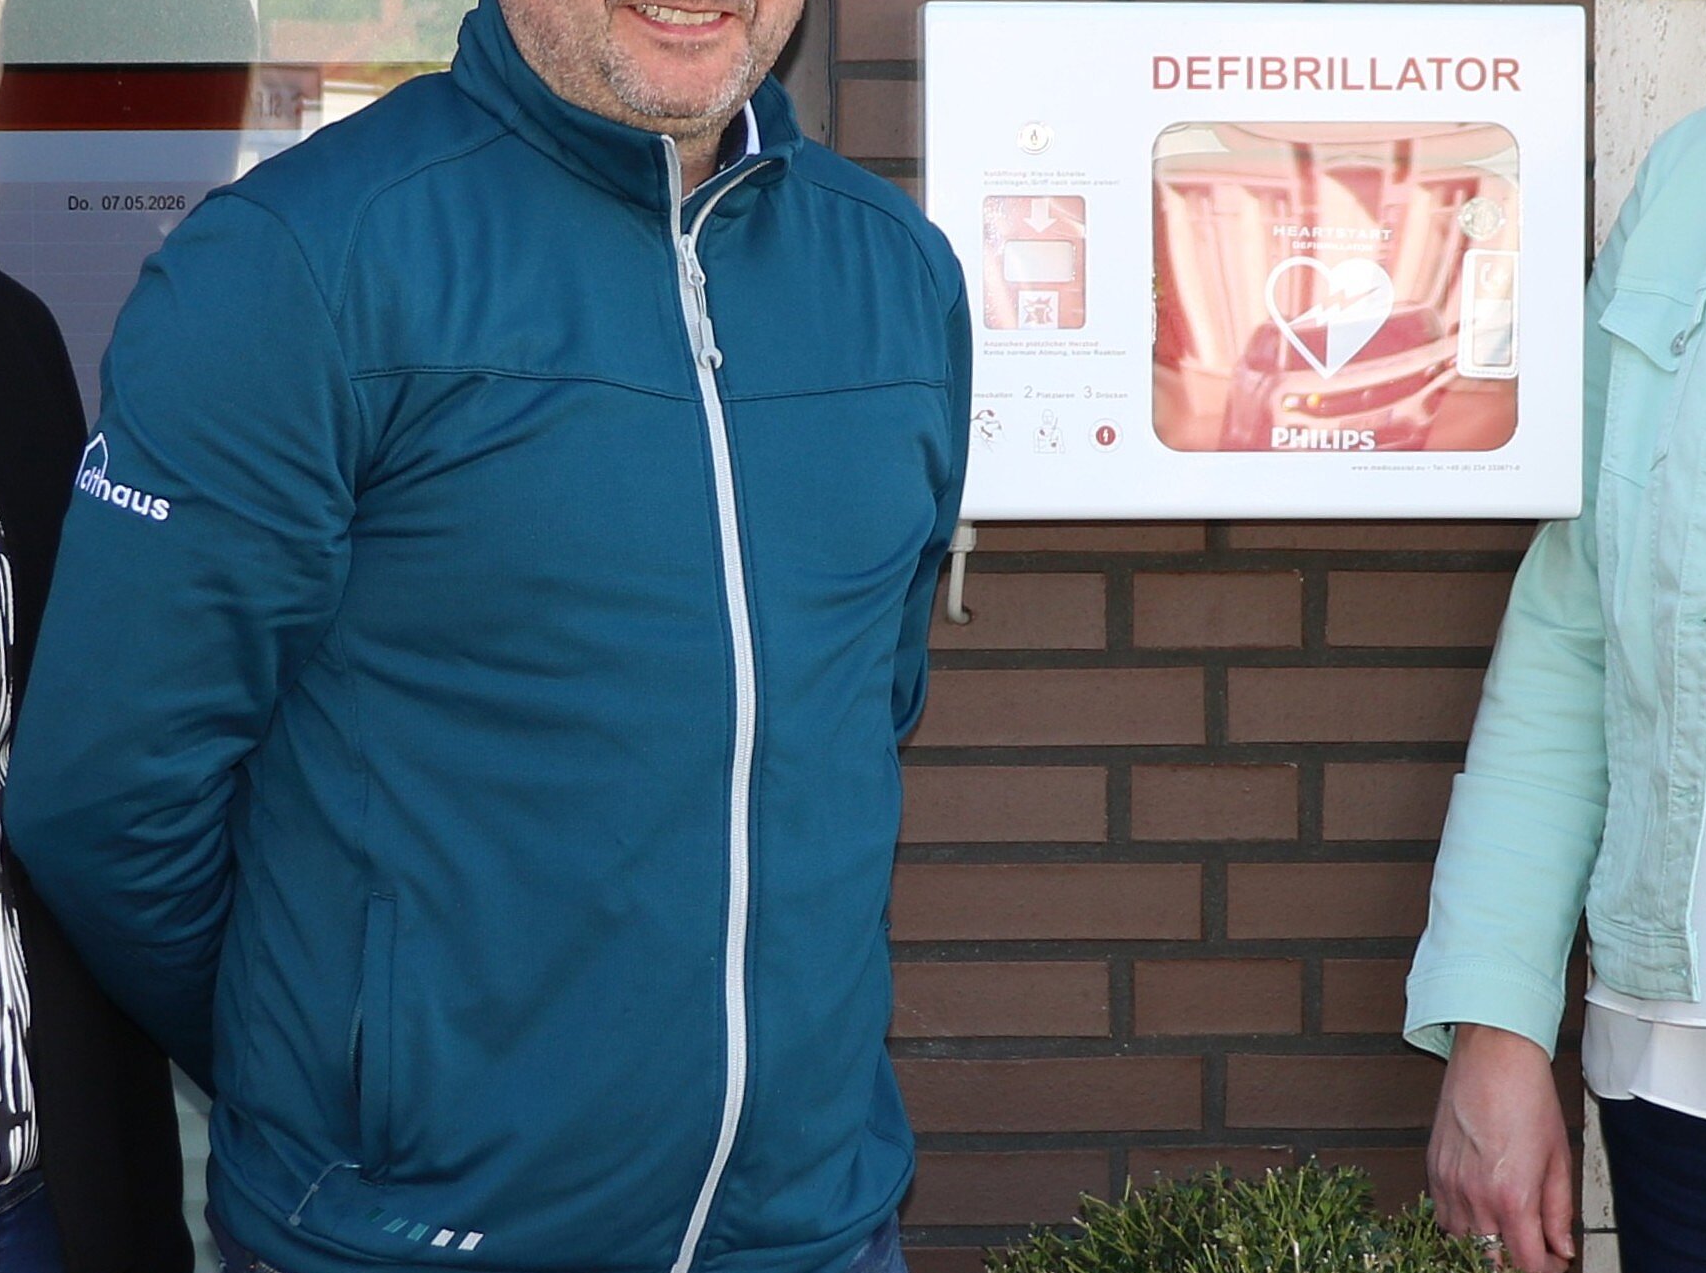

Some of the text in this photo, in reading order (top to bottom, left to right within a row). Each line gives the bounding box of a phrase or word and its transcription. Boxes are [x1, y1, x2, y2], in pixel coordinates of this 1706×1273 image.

[1151, 55, 1521, 93] DEFIBRILLATOR
[67, 195, 186, 211] Do. 07.05.2026
[1272, 224, 1393, 241] HEARTSTART
[1023, 385, 1033, 399] 2
[1083, 385, 1093, 399] 3
[1270, 425, 1376, 450] PHILIPS
